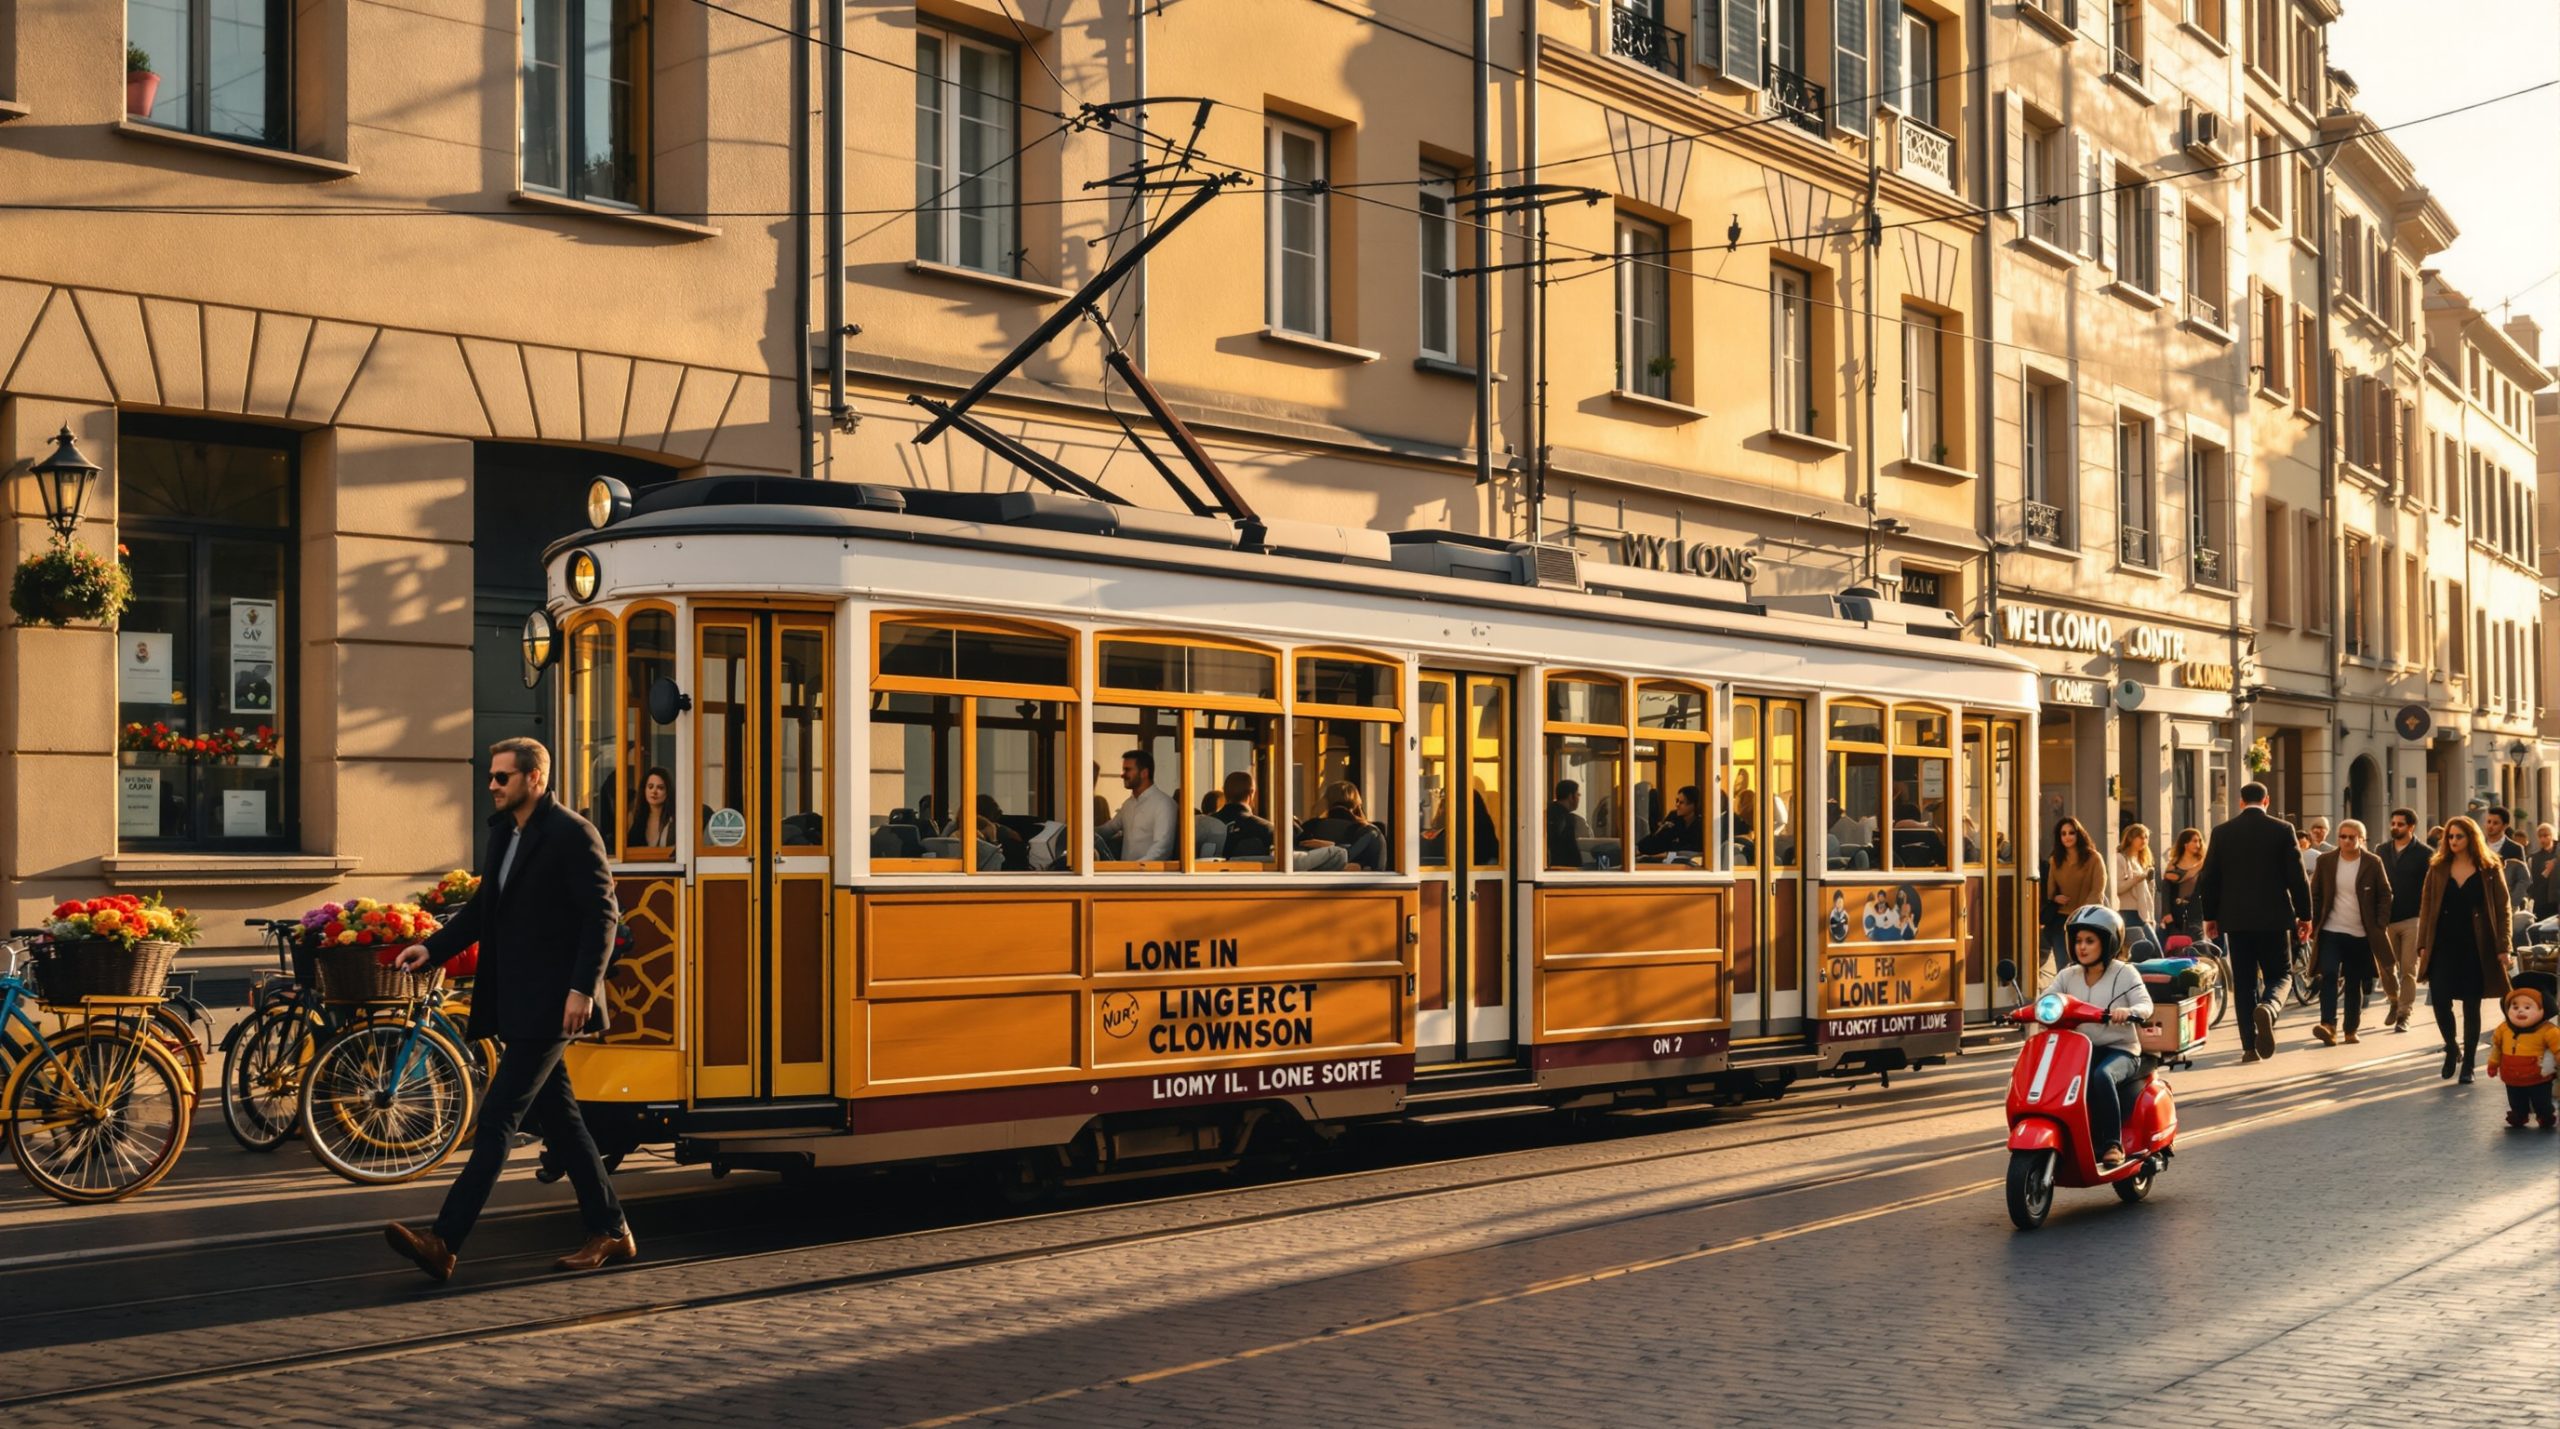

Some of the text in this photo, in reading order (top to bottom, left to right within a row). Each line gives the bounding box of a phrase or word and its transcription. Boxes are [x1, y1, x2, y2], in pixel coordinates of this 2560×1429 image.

[1125, 938, 1238, 971] LONE IN
[1159, 983, 1317, 1019] LINGERCT
[1840, 979, 1912, 1008] LONE IN
[1149, 1017, 1313, 1054] CLOWNSON
[1652, 1038, 1670, 1055] ON
[1153, 1074, 1217, 1099] LIOMY
[1259, 1066, 1315, 1091] LONE
[1322, 1059, 1383, 1084] SORTE
